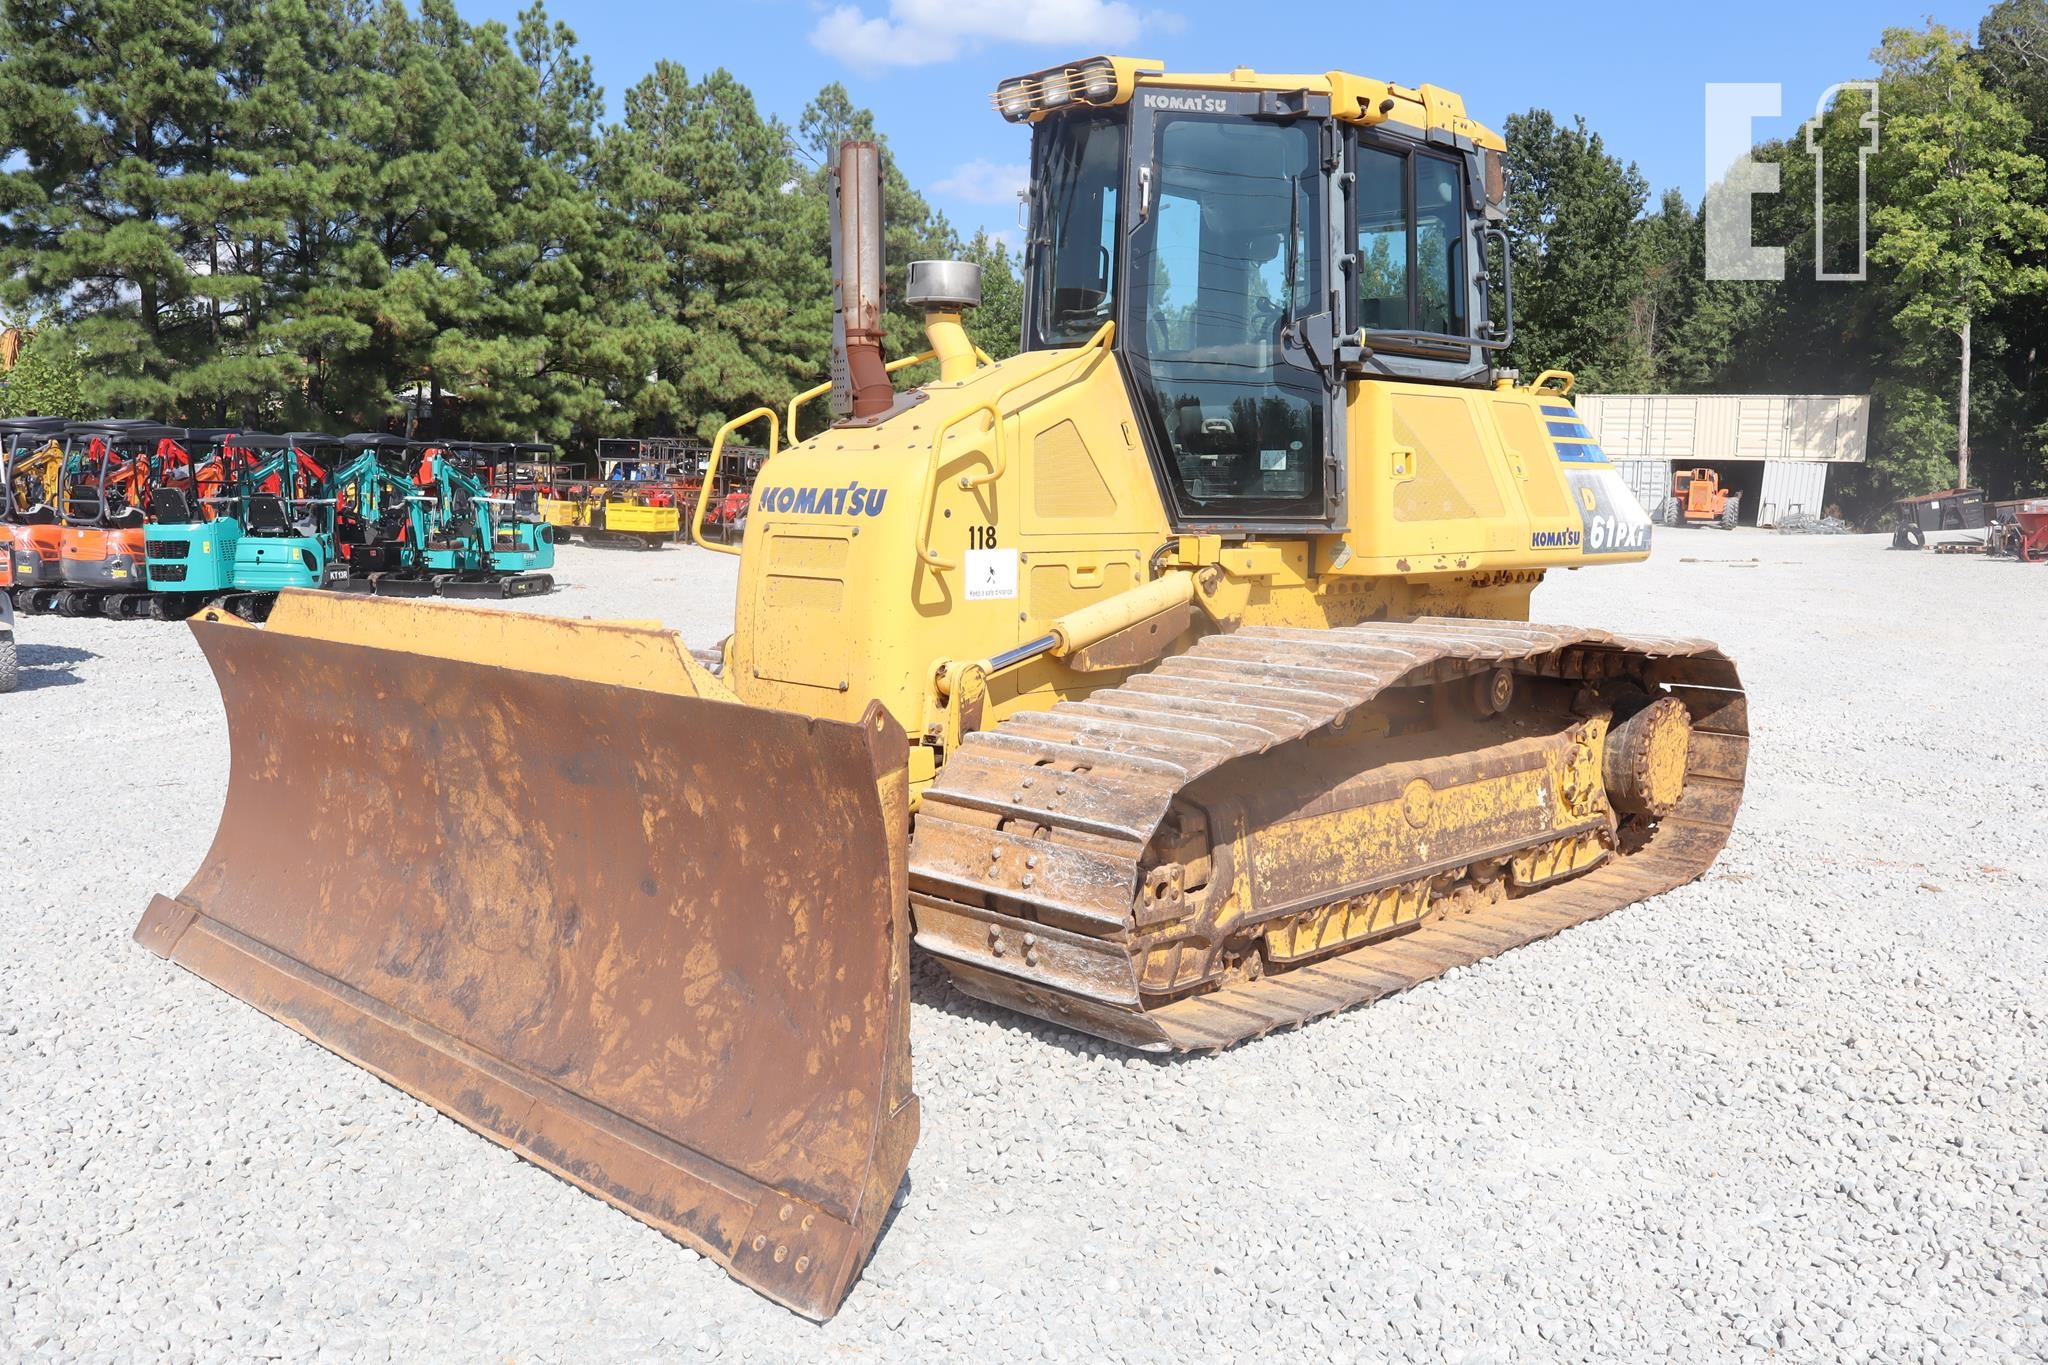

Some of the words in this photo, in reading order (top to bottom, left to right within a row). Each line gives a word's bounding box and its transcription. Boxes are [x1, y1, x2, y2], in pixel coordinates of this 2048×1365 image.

[1144, 94, 1227, 112] KOMATSU
[757, 480, 888, 517] KOMATSU
[1580, 487, 1597, 512] D
[1590, 515, 1644, 550] 61PXi
[968, 525, 997, 550] 118
[1532, 527, 1581, 548] KOMATSU
[330, 570, 348, 580] KT13R
